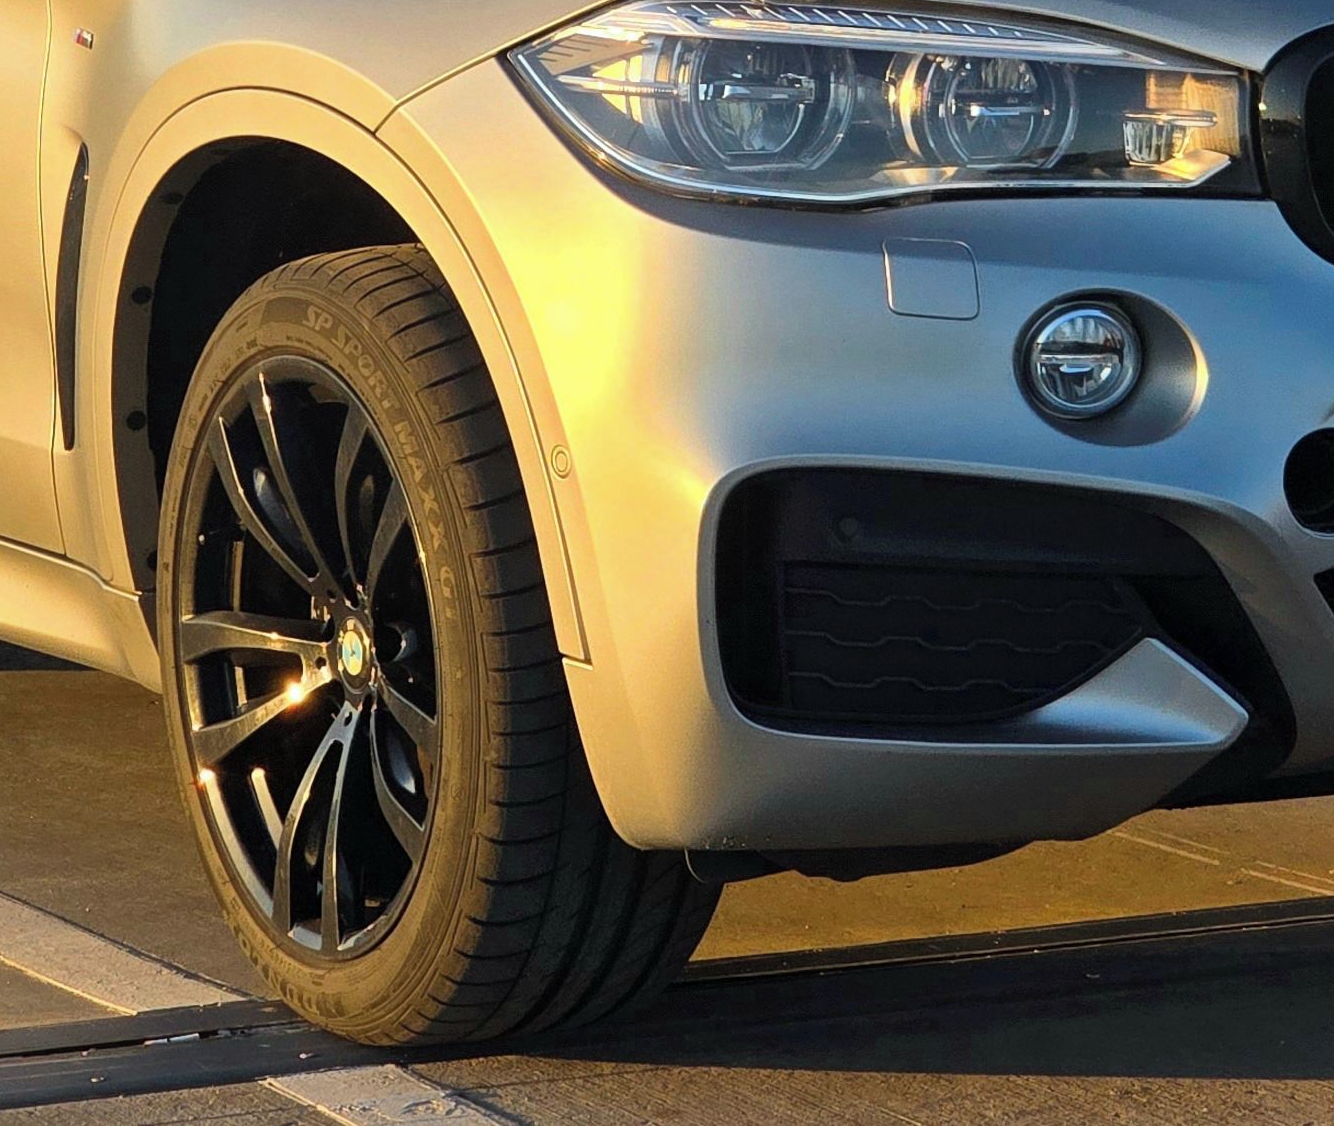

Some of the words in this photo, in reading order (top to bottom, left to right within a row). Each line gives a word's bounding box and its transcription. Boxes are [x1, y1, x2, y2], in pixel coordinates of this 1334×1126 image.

[301, 304, 334, 331] SP
[330, 326, 401, 410] SPORT
[394, 421, 450, 553] MAXX
